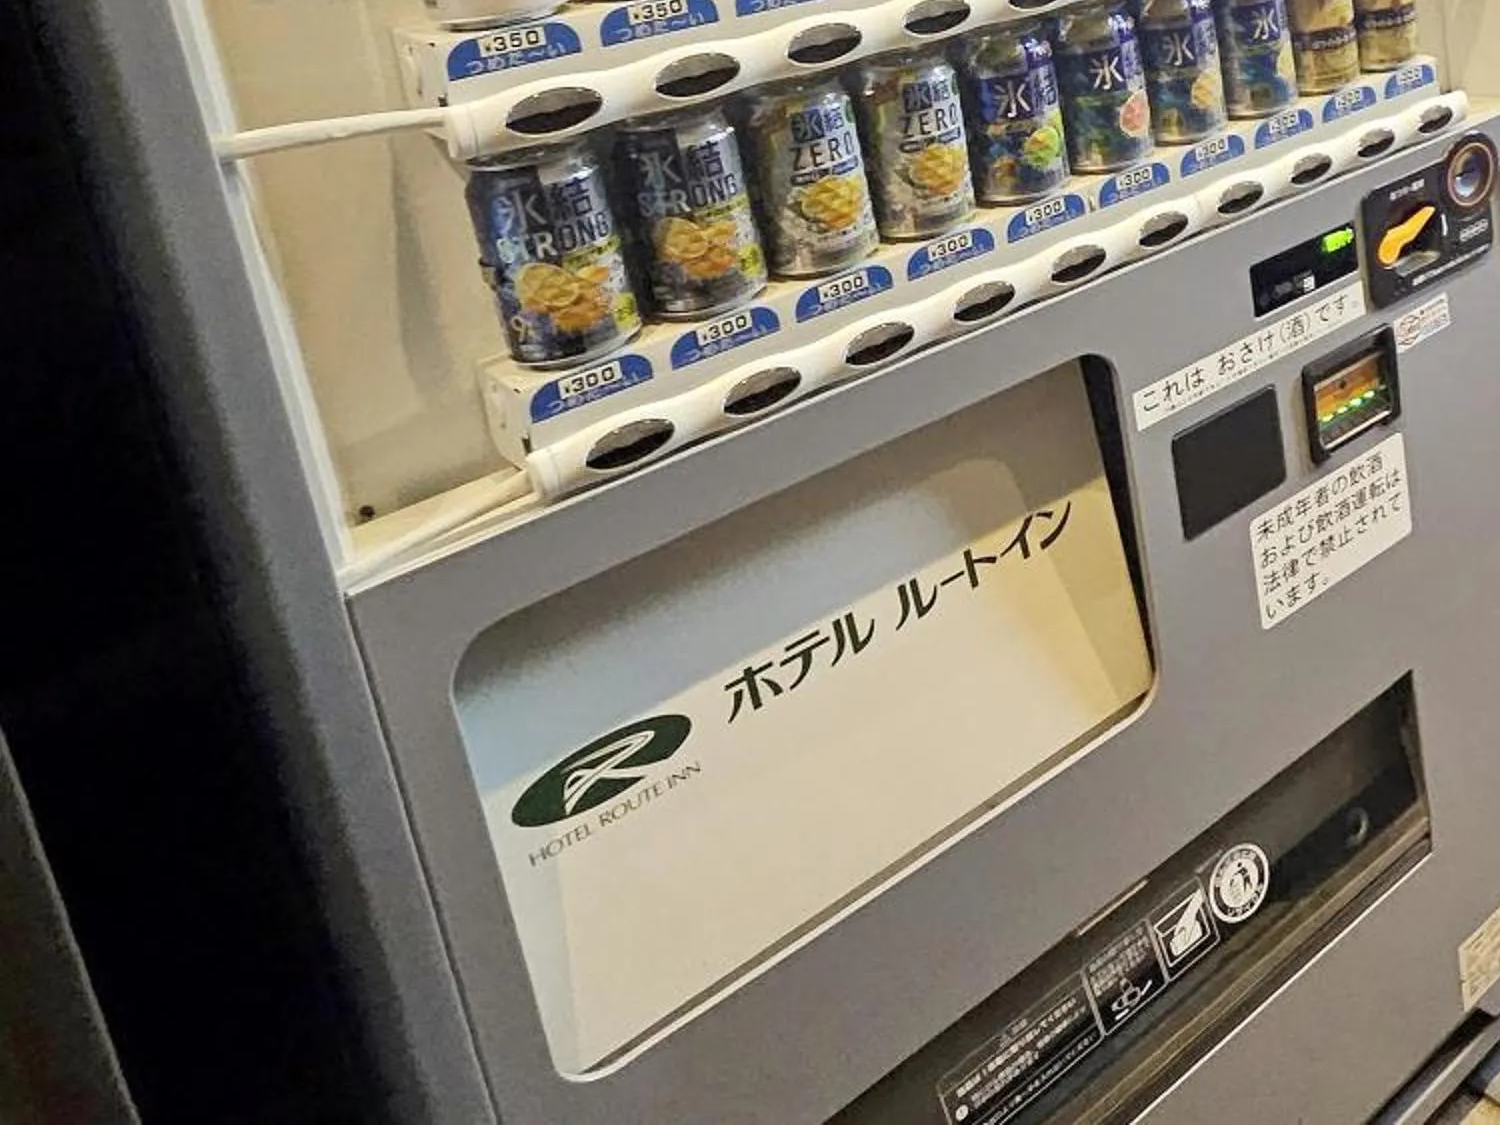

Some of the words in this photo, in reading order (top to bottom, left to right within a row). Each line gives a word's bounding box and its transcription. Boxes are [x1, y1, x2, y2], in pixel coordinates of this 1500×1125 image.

[484, 29, 540, 52] ¥350
[1162, 32, 1195, 66] 氷
[1089, 54, 1124, 91] 氷
[901, 102, 957, 138] ZERO
[994, 83, 1031, 118] 氷
[790, 131, 855, 172] ZERO
[823, 275, 864, 299] ¥300
[702, 315, 748, 341] ¥300
[564, 367, 616, 394] ¥300
[1143, 367, 1205, 412] これは
[1257, 452, 1384, 540] 未成年者の飲酒
[1260, 469, 1402, 569] および飲酒運転は
[1263, 492, 1402, 597] 法律で禁止されて
[724, 612, 876, 723] ホテル
[896, 501, 1072, 631] ルートイン
[1265, 572, 1330, 620] います。
[528, 822, 592, 868] HOTEL
[599, 784, 665, 827] ROUTE
[667, 760, 702, 790] INN
